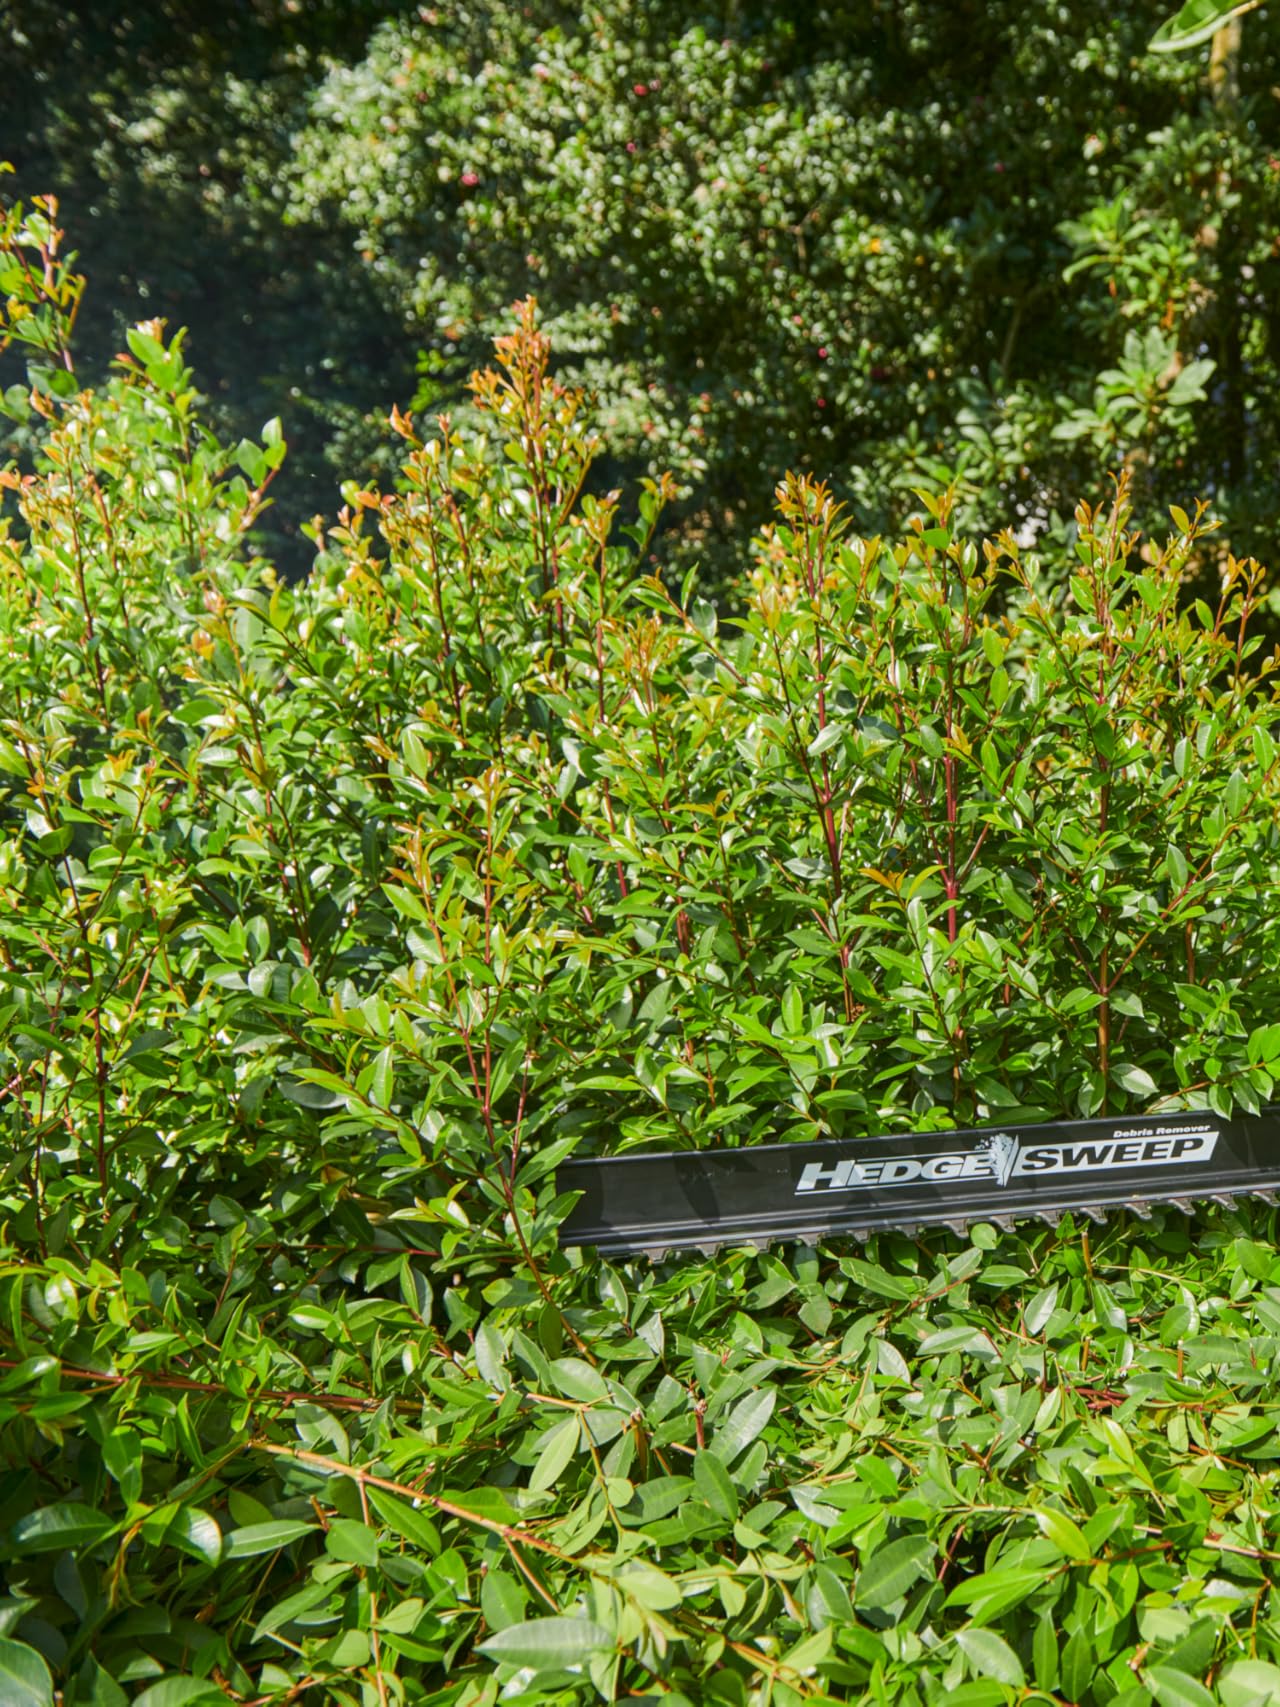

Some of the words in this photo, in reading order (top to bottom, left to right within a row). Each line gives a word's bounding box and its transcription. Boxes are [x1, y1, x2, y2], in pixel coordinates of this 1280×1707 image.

[1113, 1128, 1153, 1138] Debris
[1156, 1125, 1210, 1135] Remover
[796, 1156, 996, 1190] HEDGE
[1021, 1138, 1204, 1170] SWEEP
